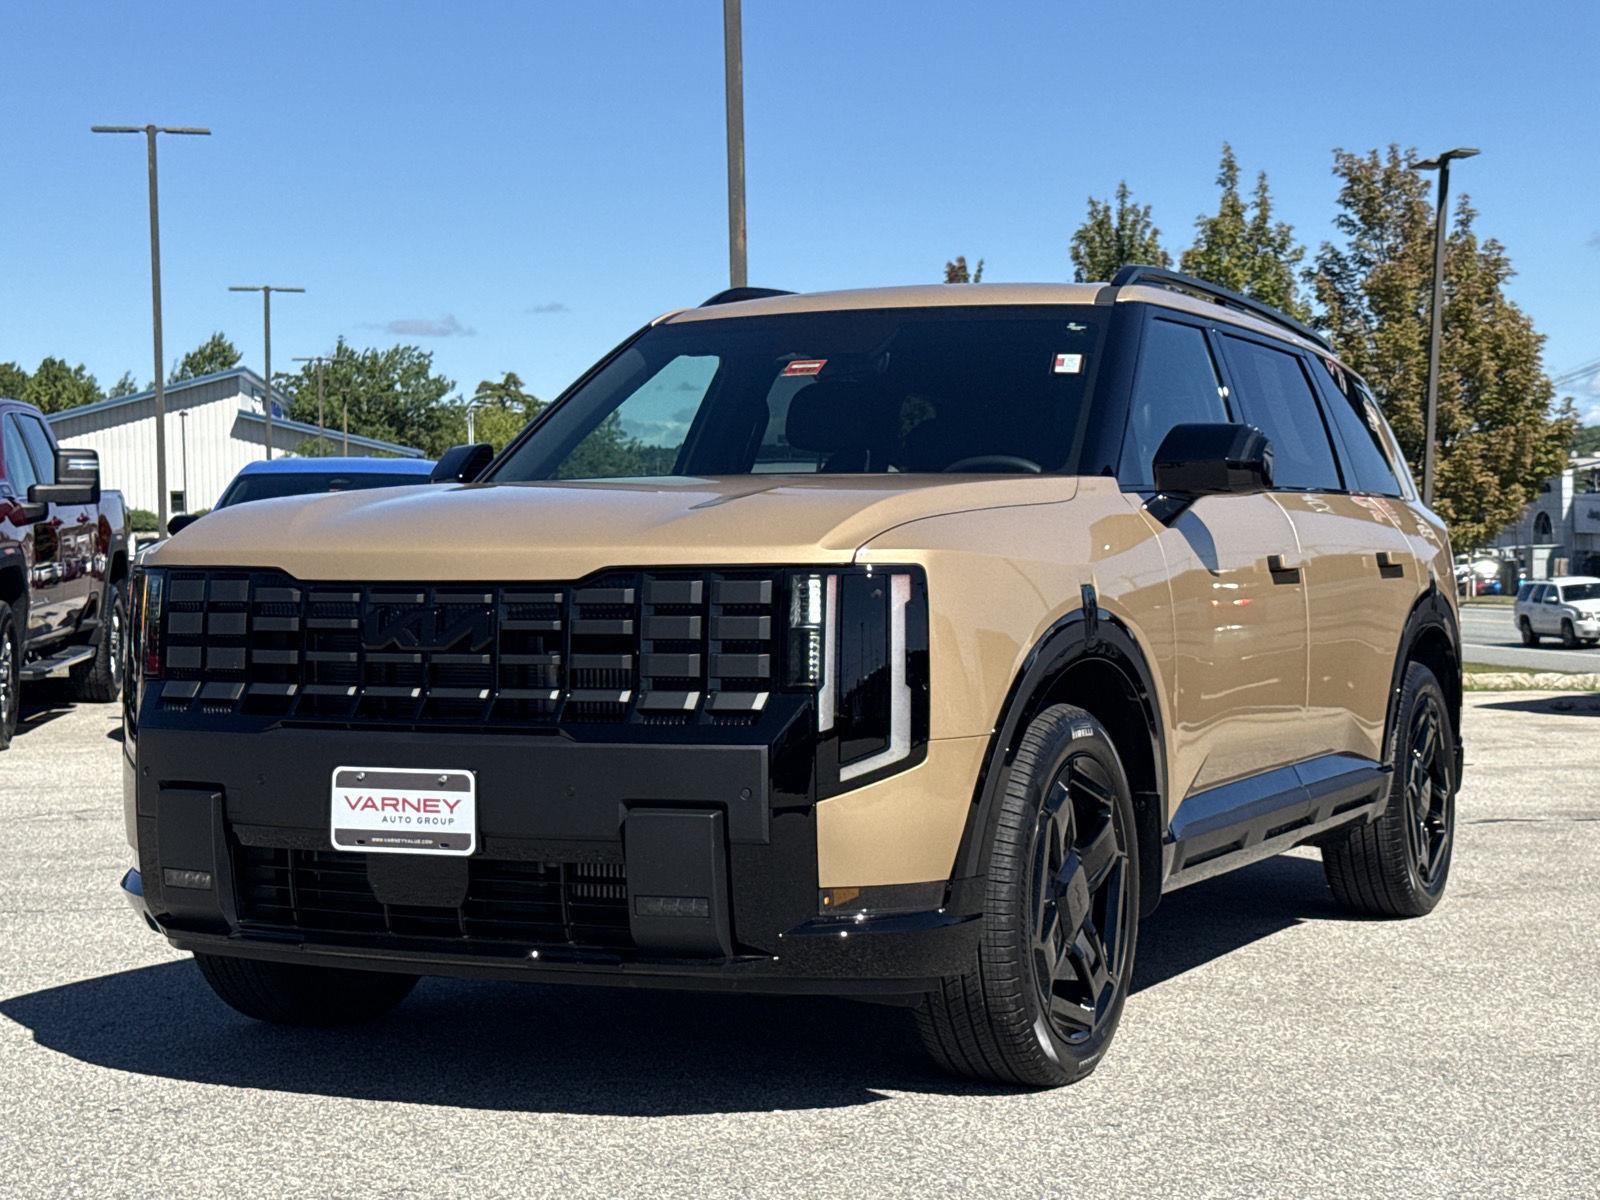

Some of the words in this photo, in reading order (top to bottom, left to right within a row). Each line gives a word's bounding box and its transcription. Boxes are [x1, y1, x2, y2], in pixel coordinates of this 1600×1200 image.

[343, 795, 462, 814] VARNEY
[381, 815, 412, 824] AUTO
[416, 816, 455, 826] GROUP
